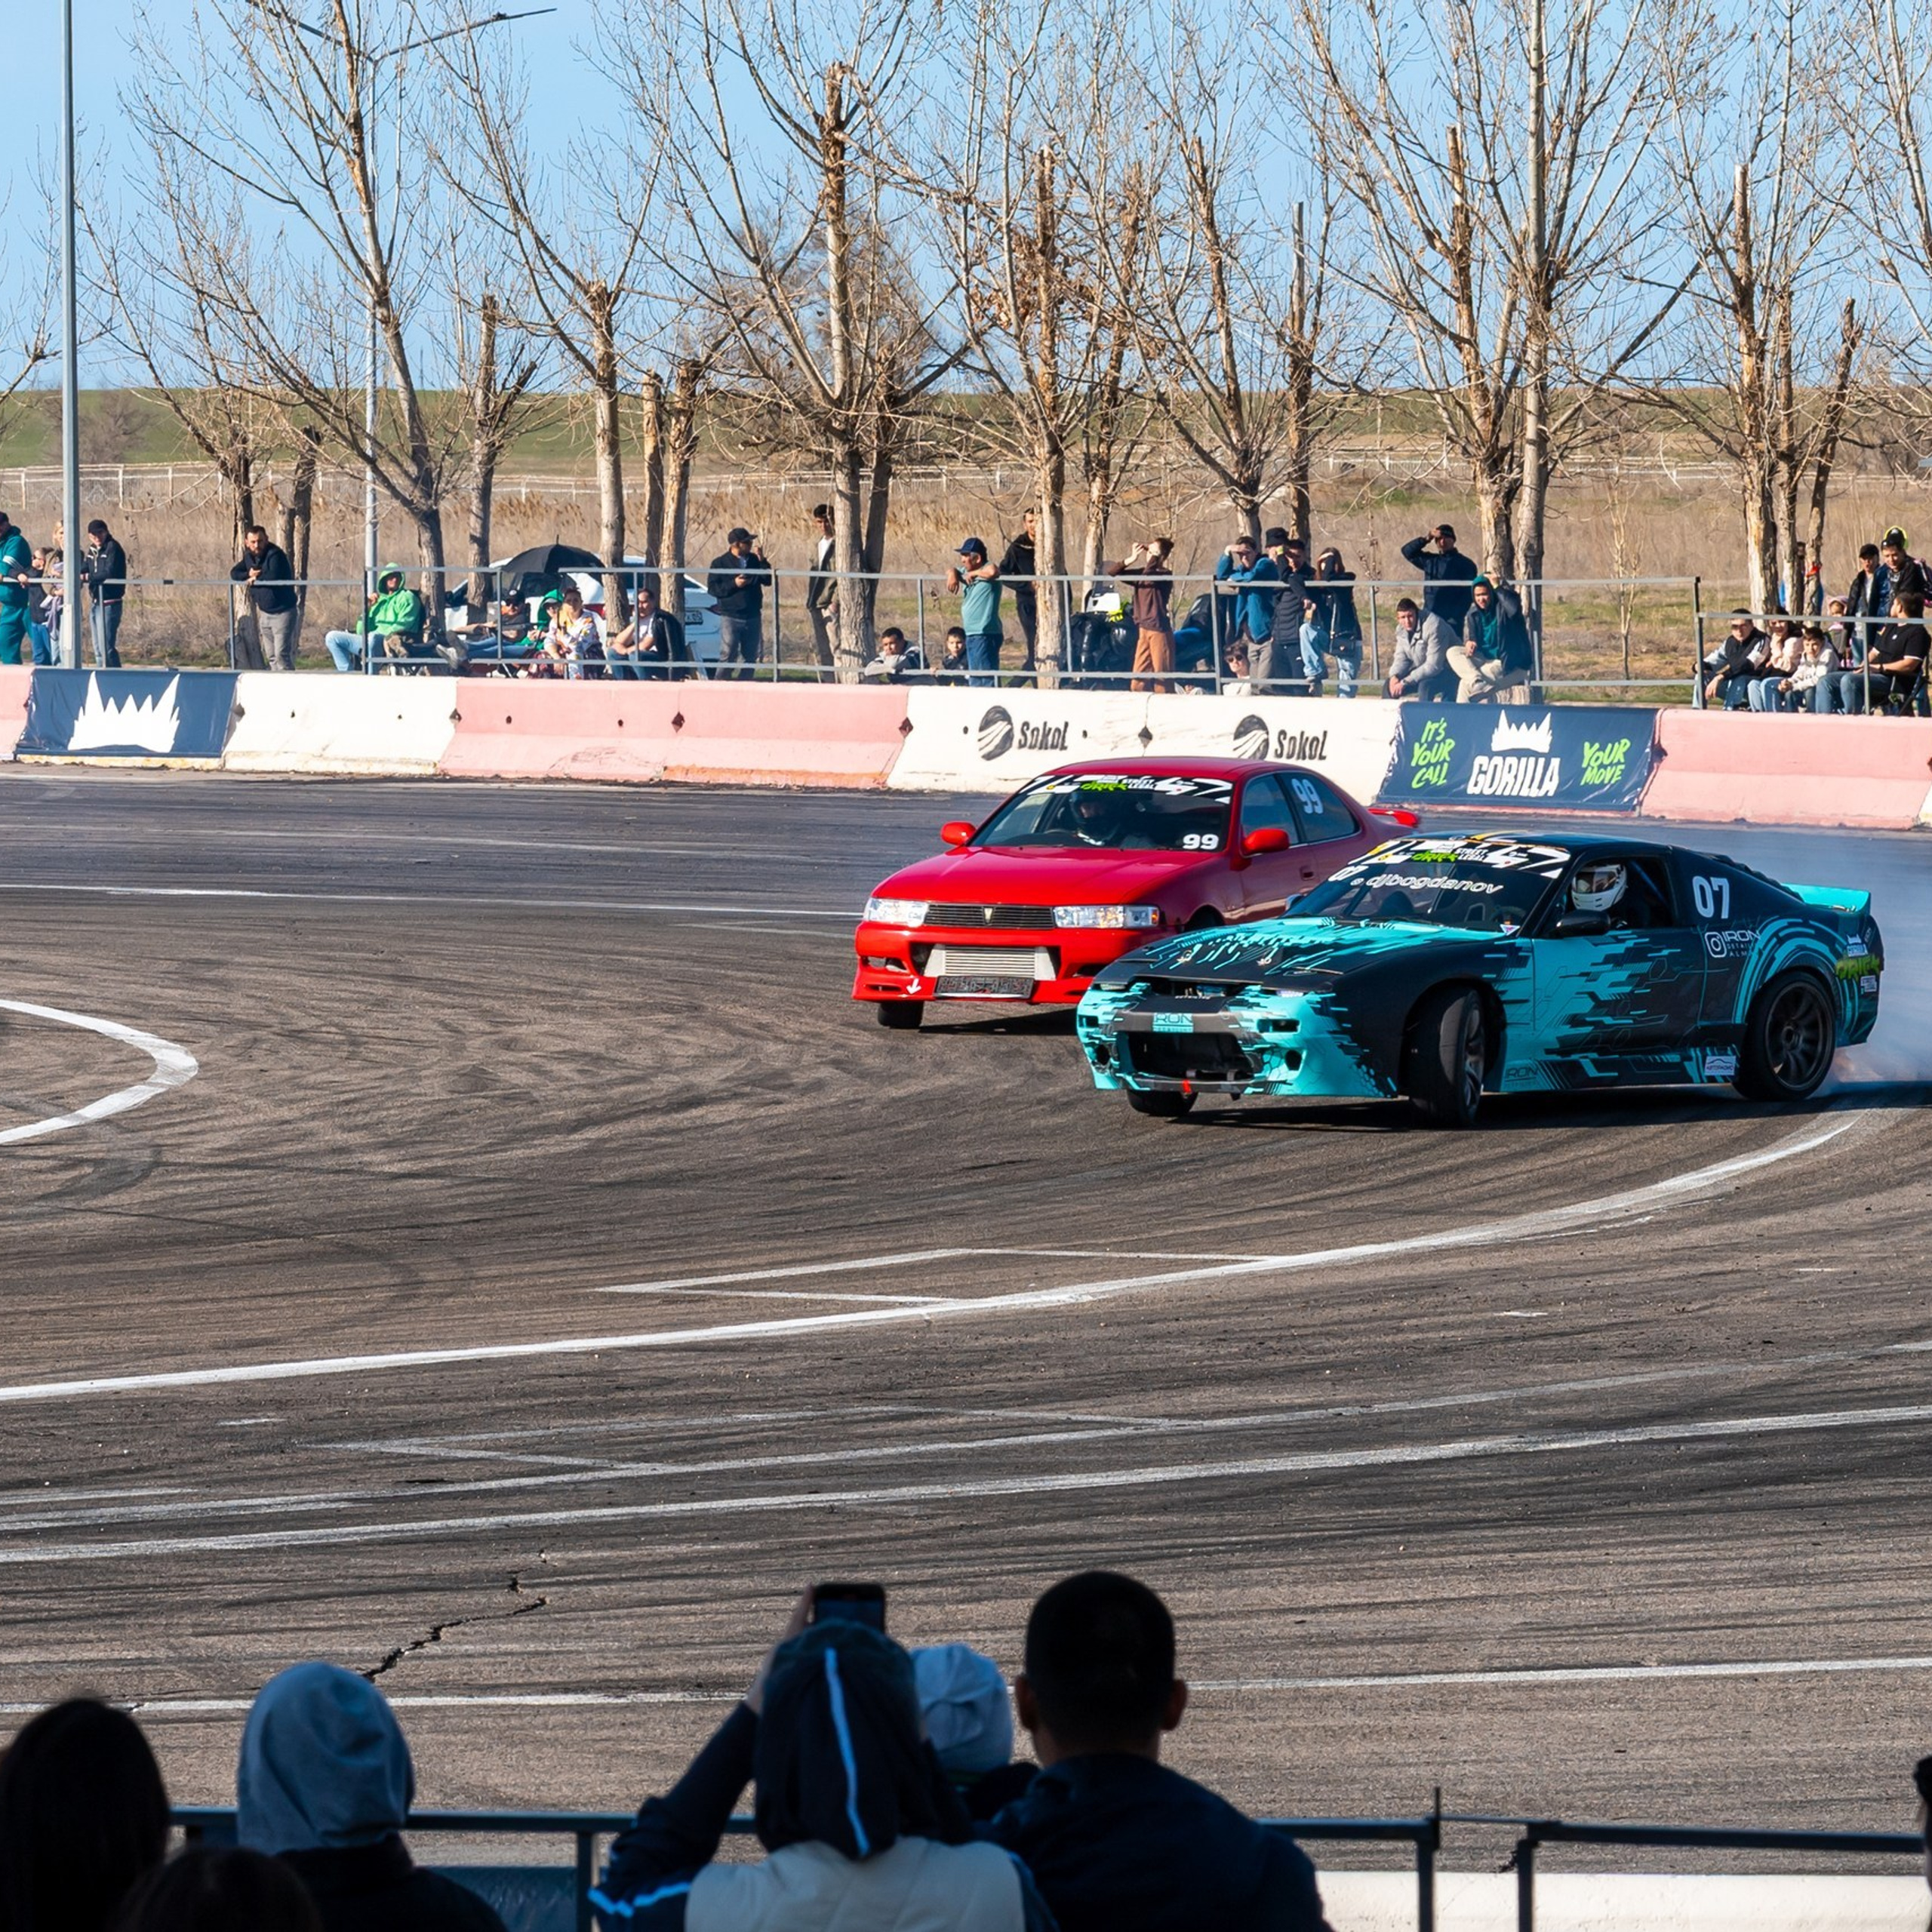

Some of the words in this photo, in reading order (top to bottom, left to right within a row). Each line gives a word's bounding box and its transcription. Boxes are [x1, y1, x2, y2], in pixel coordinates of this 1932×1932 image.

[1420, 718, 1447, 743] IT'S
[1411, 739, 1455, 767] YOUR
[1581, 738, 1631, 768] YOUR
[1411, 763, 1448, 789] CALL
[1466, 755, 1561, 797] GORILLA
[1580, 764, 1626, 786] MOVE
[1291, 778, 1324, 815] 99
[1182, 834, 1219, 851] 99
[1366, 873, 1504, 895] djbogdanov
[1691, 875, 1730, 919] 07
[1721, 930, 1761, 942] IRON
